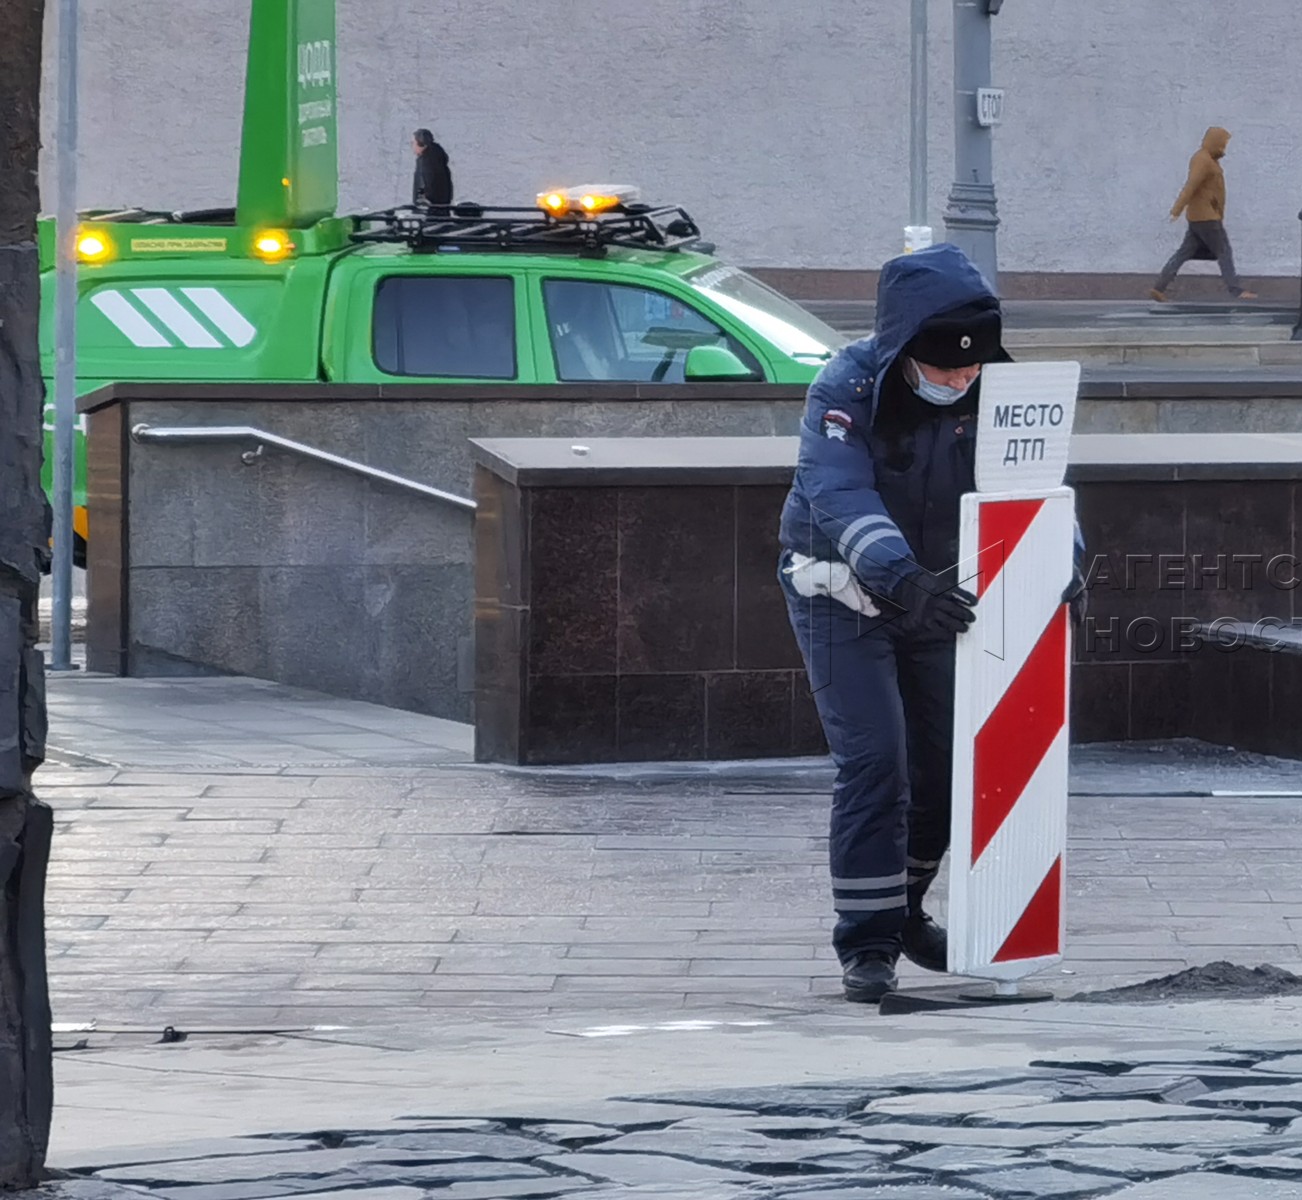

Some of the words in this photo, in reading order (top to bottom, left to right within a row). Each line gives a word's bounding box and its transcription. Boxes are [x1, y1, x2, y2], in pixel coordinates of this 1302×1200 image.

[297, 40, 331, 89] ЦОДД
[993, 403, 1064, 428] МЕСТО
[1003, 438, 1045, 466] ДТП
